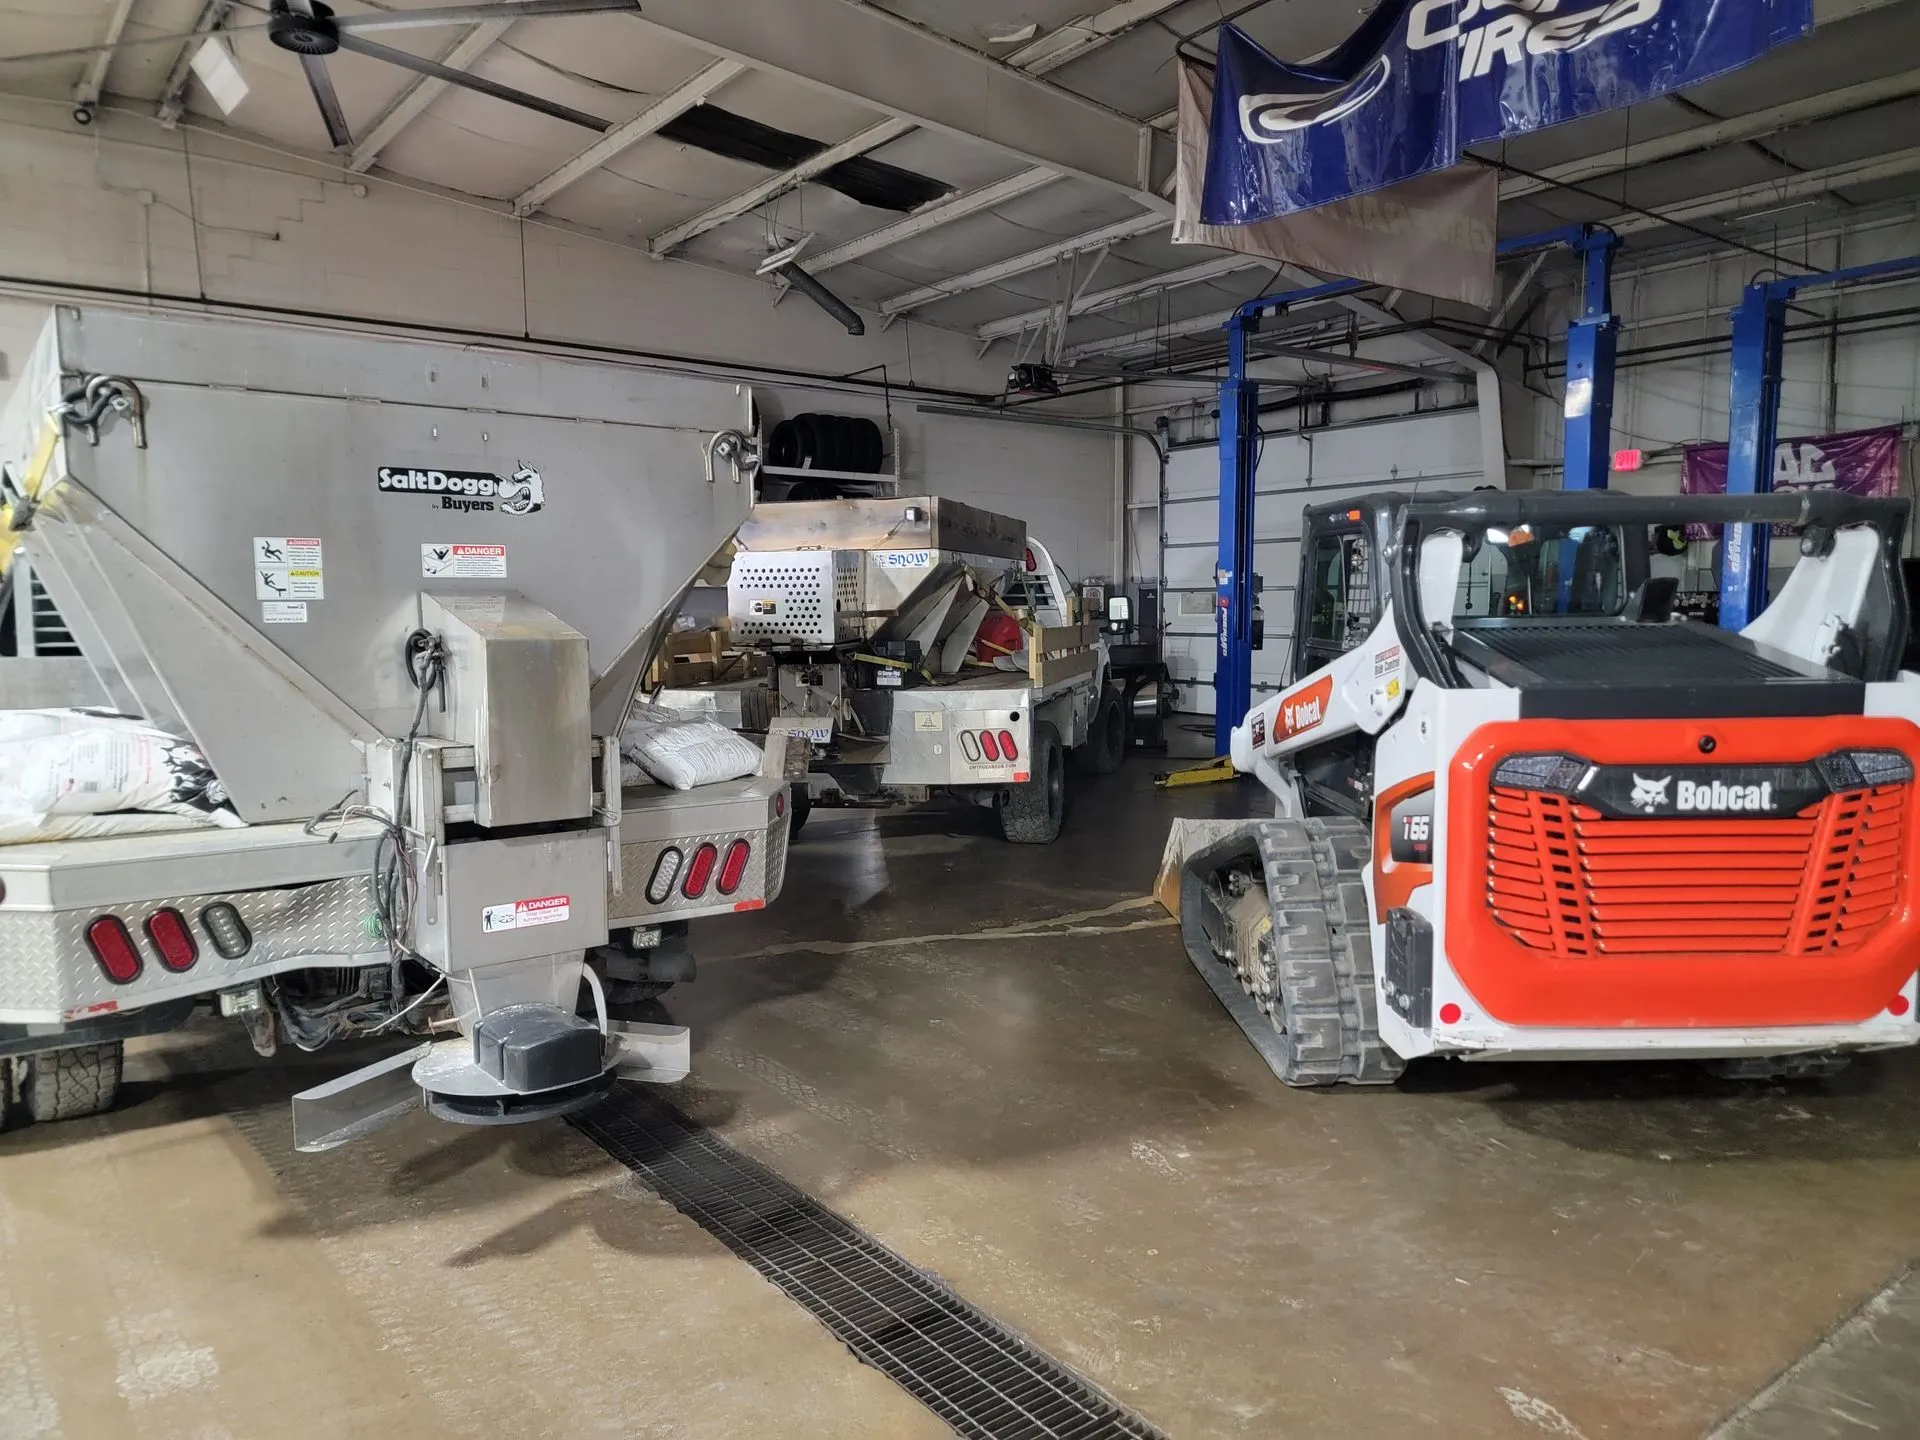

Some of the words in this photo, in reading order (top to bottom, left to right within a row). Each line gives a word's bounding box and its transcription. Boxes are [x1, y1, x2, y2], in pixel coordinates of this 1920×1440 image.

[379, 467, 496, 496] SaltDogg
[441, 495, 495, 513] Buyers
[465, 547, 502, 555] DANGER
[1295, 696, 1321, 730] Bobcat
[1676, 780, 1772, 811] Bobcat
[1403, 815, 1430, 841] T66
[528, 897, 567, 909] DANGER
